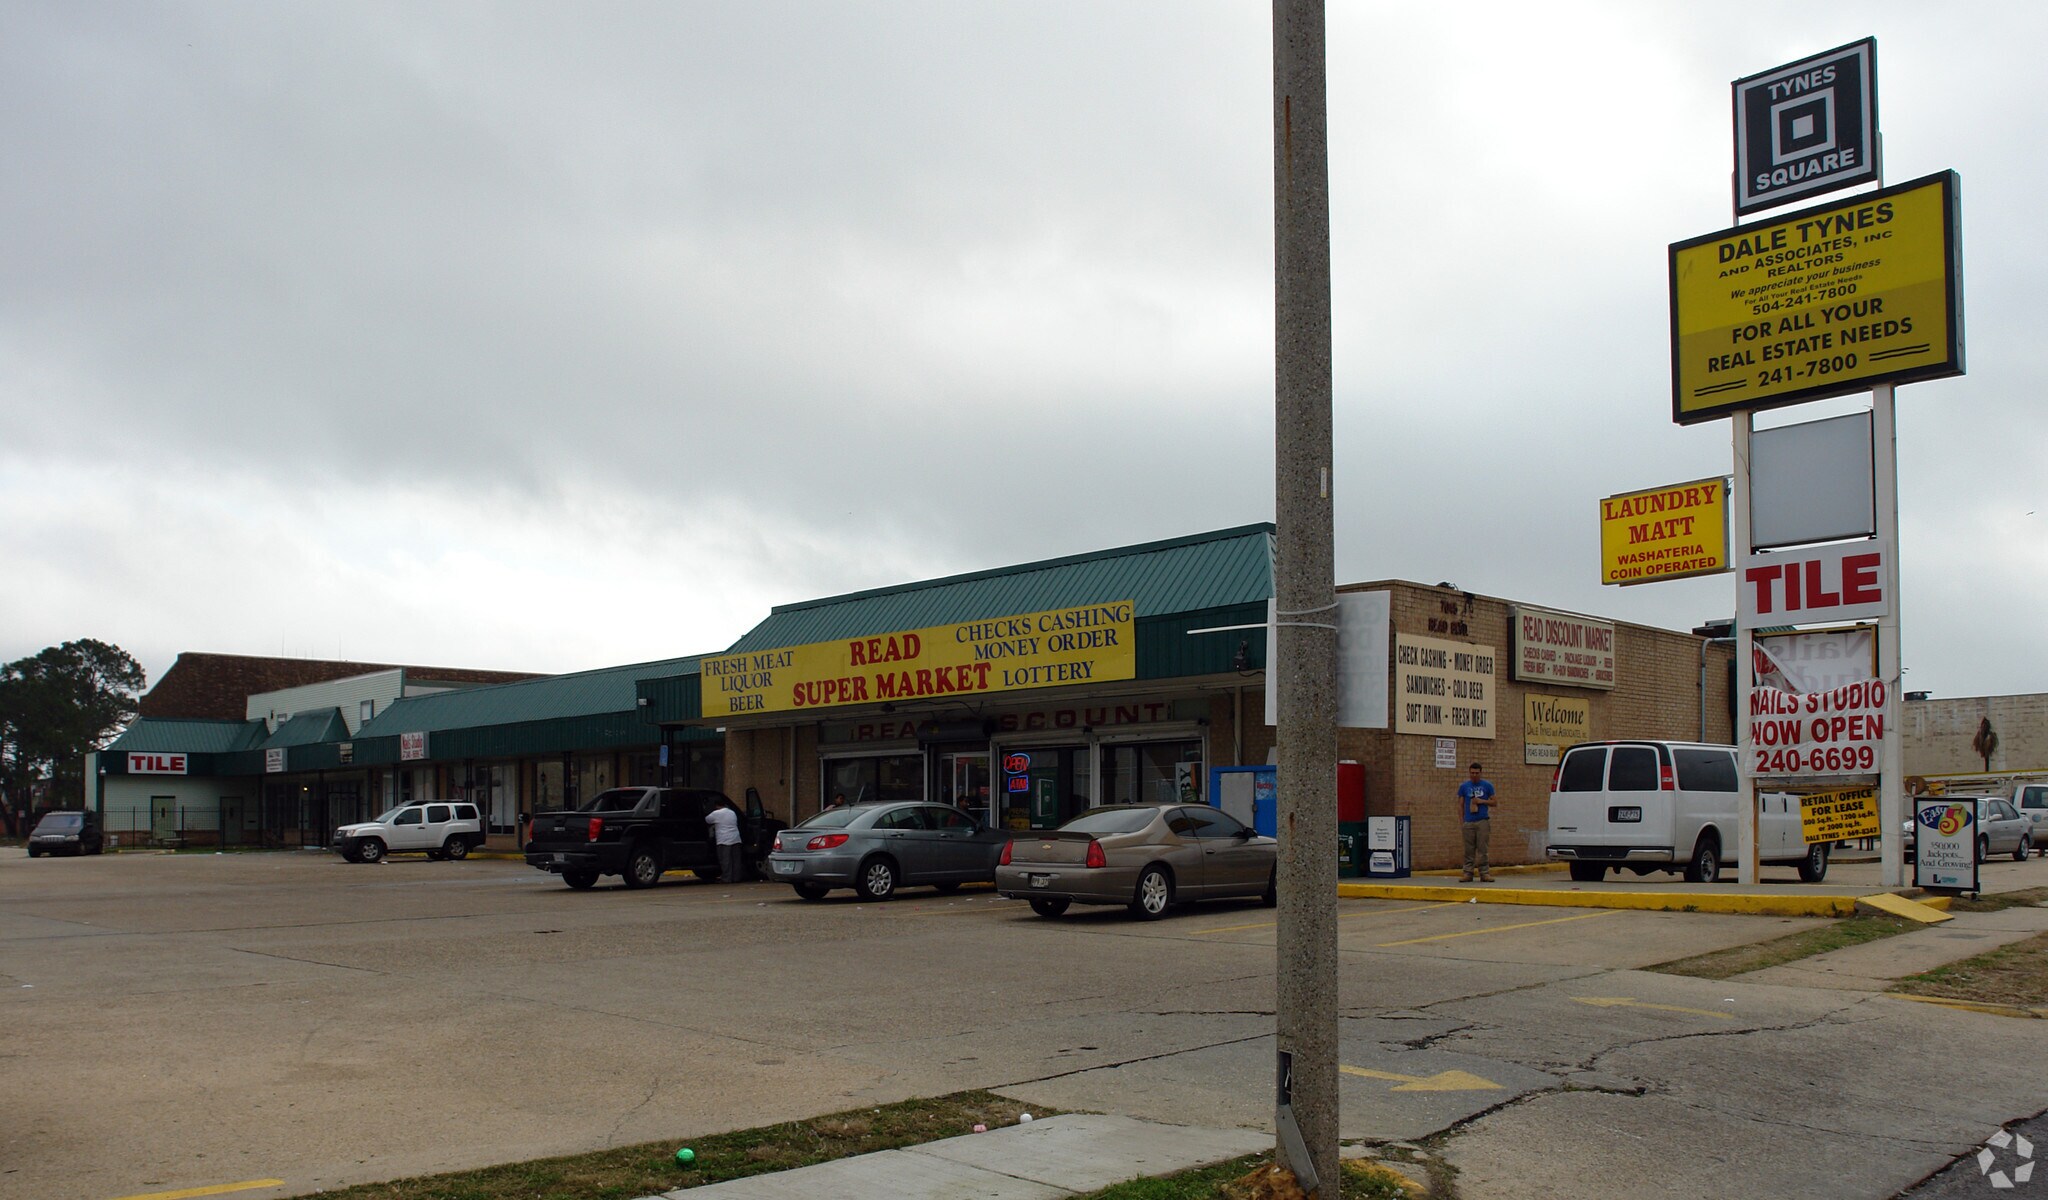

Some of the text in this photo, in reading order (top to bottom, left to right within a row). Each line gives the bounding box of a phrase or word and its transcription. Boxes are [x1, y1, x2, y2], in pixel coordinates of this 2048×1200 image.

[1768, 65, 1836, 100] TYNES
[1756, 147, 1855, 190] SQUARE
[1719, 202, 1894, 264] DALE TYNES
[1718, 230, 1893, 278] AND ASSOCIATES, INC
[1767, 252, 1844, 278] REALTORS
[1731, 258, 1881, 299] We appreciate your business
[1744, 273, 1863, 306] For All Your Real Estate Needs
[1753, 283, 1857, 315] 504-241-7800
[1732, 298, 1883, 344] FOR ALL YOUR
[1708, 317, 1913, 373] REAL ESTATE NEEDS
[1758, 353, 1857, 388] 241-7800
[1604, 484, 1717, 521] LAUNDRY
[1629, 516, 1695, 544] MATT
[1610, 556, 1716, 580] COIN OPERATED
[1617, 544, 1704, 565] WASHATERIA
[1745, 552, 1882, 614] TILE
[955, 605, 1130, 643] CHECKS CASHING
[1523, 615, 1612, 652] READ DISCOUNT MARKET
[850, 633, 921, 666] READ
[974, 629, 1118, 661] MONEY ORDER
[1399, 645, 1493, 674] CHECK CASHING MONEY ORDER
[705, 651, 794, 676] FRESH MEAT
[1003, 660, 1095, 687] LOTTERY
[721, 671, 773, 692] LIQUOR
[793, 662, 991, 707] SUPER MARKET
[1406, 674, 1483, 700] SANDWICHES COLD BEER
[730, 695, 765, 712] BEER
[1531, 699, 1584, 725] Welcome
[1751, 681, 1885, 715] NAILS STUDIO
[1406, 703, 1487, 727] SOFT DRINK FRESH MEAT
[1752, 715, 1883, 745] NOW OPEN
[130, 755, 185, 771] TILE
[1004, 755, 1028, 771] OPEN
[1756, 746, 1874, 772] 240-6699
[1010, 779, 1027, 789] ATM
[1801, 789, 1872, 807] RETAIL/OFFICE
[1812, 801, 1864, 816] FOR LEASE
[1822, 832, 1839, 840] TYNES
[1920, 859, 1935, 867] And
[1938, 860, 1973, 870] Growing!
